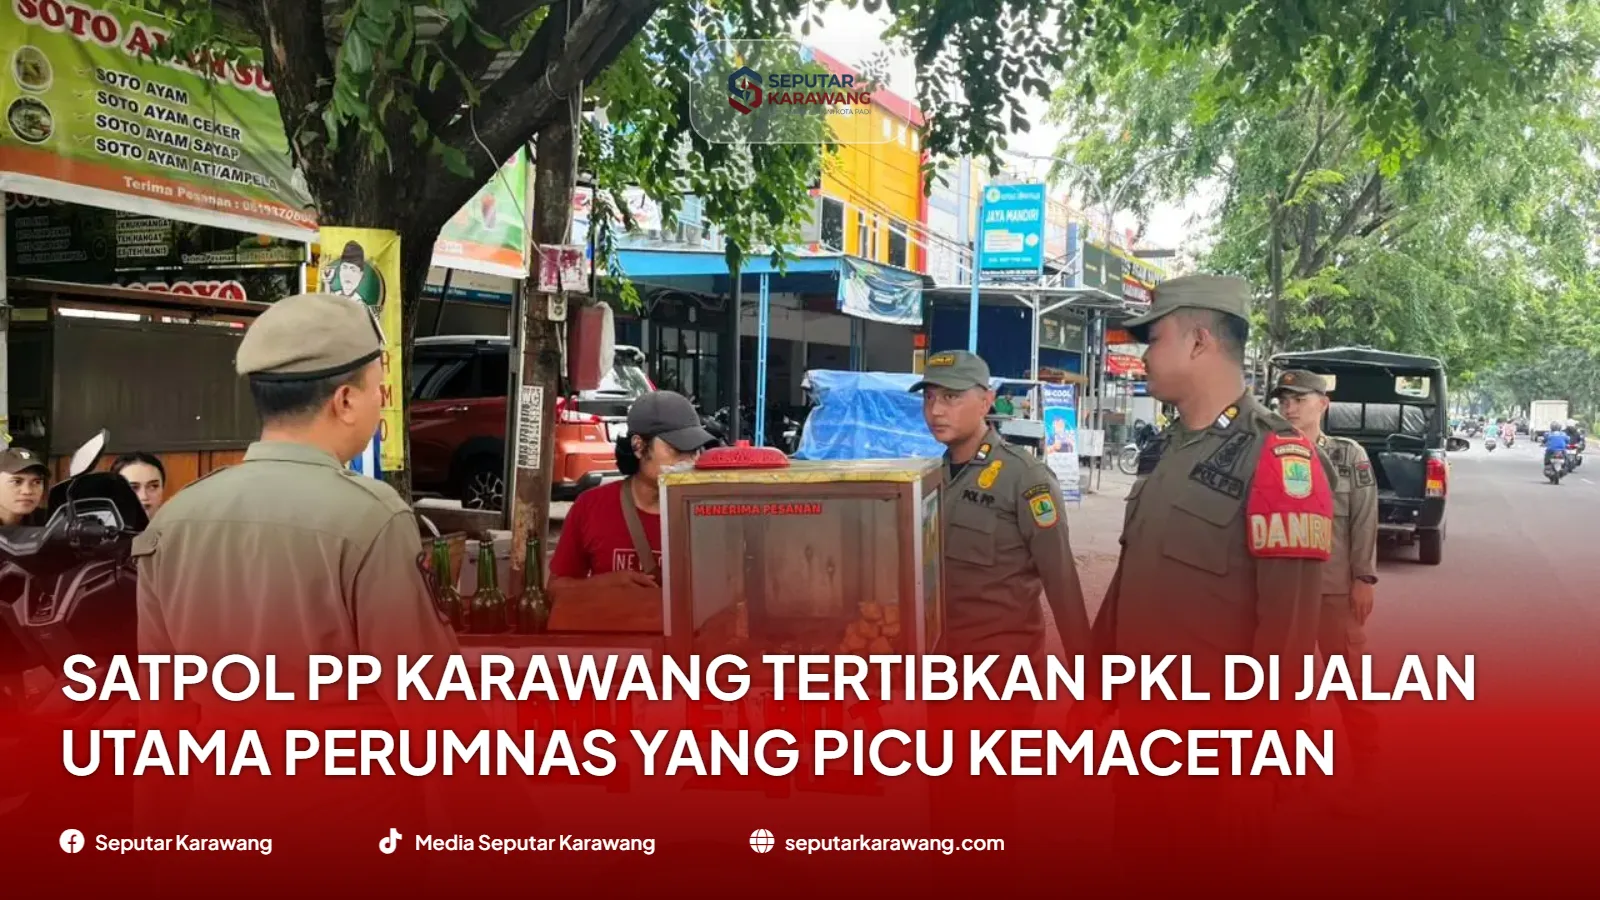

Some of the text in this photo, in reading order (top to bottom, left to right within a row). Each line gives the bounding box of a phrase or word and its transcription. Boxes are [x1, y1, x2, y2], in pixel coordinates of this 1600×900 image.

[17, 0, 118, 42] SOTO
[96, 68, 188, 104] SOTO AYAM
[97, 91, 241, 141] SOTO AYAM CEKER
[96, 114, 239, 161] SOTO AYAM SAYAP
[96, 138, 280, 192] SOTO AYAM ATI/AMPELA
[123, 175, 173, 197] Terima
[177, 186, 232, 209] Pesanan
[986, 209, 1040, 223] JAYA MANDIRI
[694, 502, 822, 516] MENERIMA PESANAN
